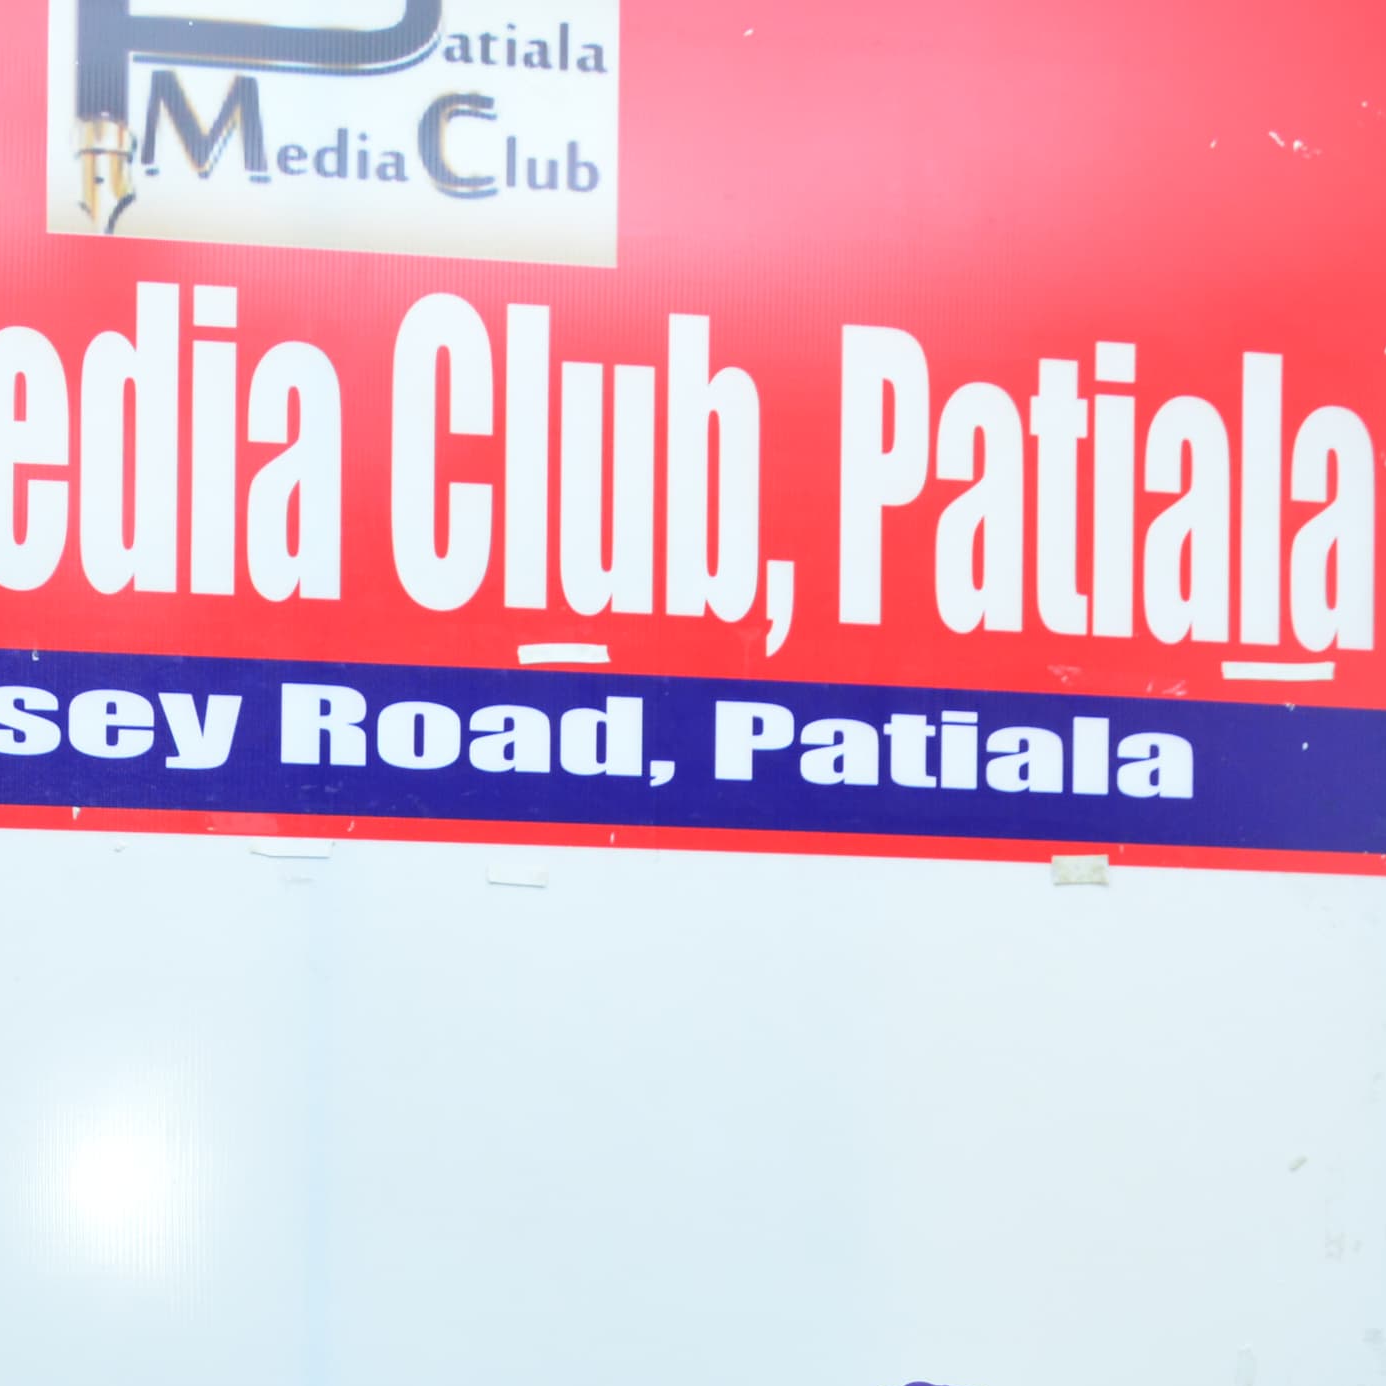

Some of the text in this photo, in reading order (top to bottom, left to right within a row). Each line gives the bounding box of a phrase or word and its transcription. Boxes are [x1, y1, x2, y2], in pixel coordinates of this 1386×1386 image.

[140, 70, 599, 199] Media Club
[391, 291, 794, 656] Club,
[839, 324, 1375, 652] Patiala
[281, 683, 675, 787] Road,
[714, 701, 1193, 798] Patiala
